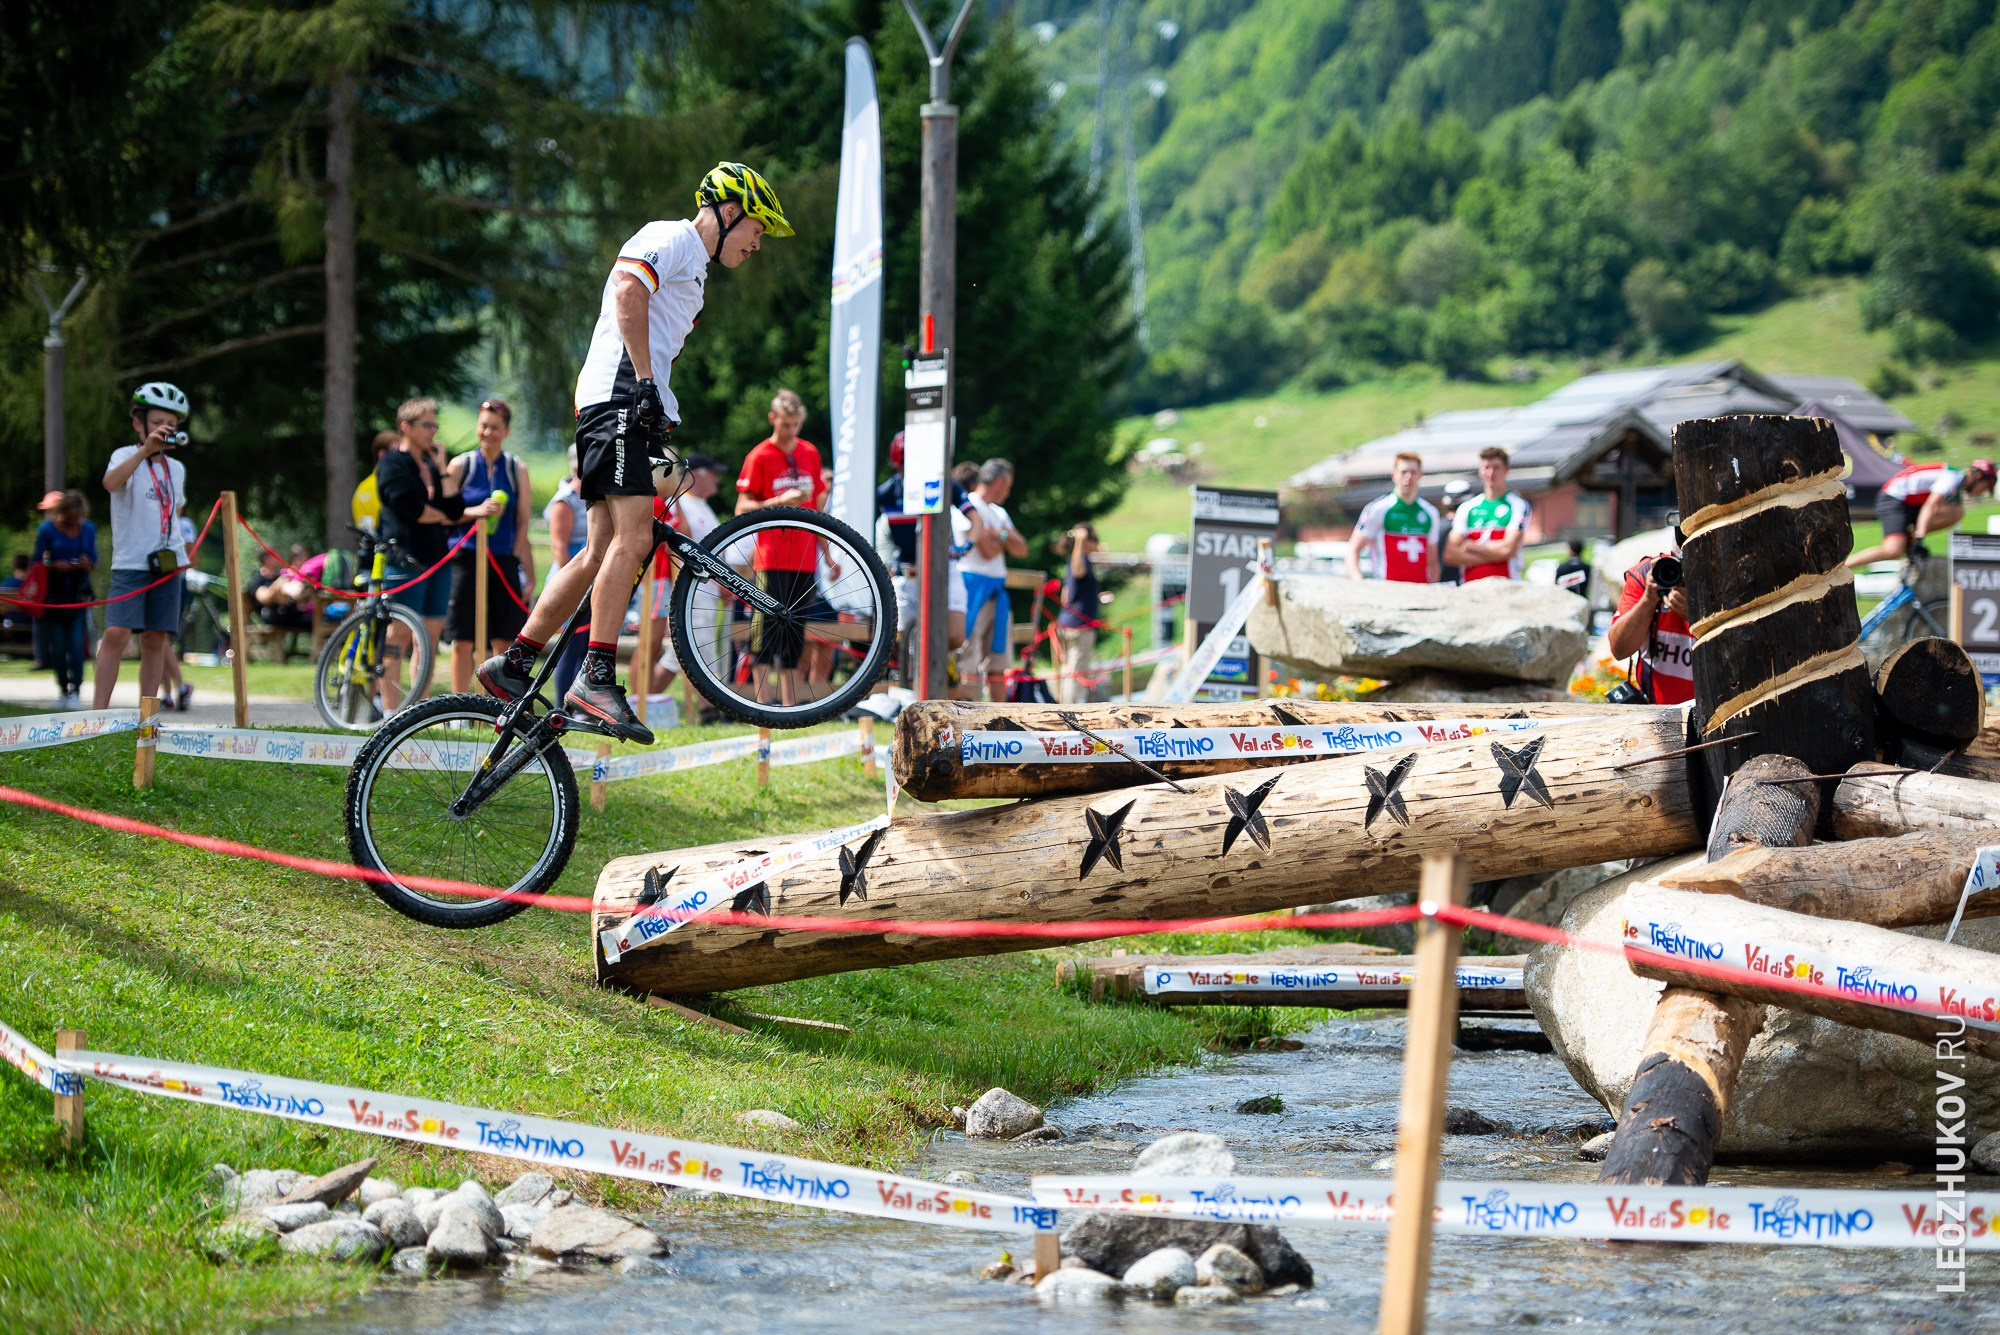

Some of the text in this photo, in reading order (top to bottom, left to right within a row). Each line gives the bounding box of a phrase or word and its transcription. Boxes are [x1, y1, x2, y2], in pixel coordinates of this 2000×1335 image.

[616, 408, 628, 436] TEAM
[1219, 567, 1242, 615] 1
[1971, 598, 1999, 642] 2
[1655, 642, 1693, 667] PHO
[962, 741, 1023, 760] ENTINO
[1038, 736, 1067, 757] Val
[1069, 743, 1082, 756] di
[1134, 735, 1214, 758] TRENTINO
[1229, 732, 1259, 752] Val
[1260, 738, 1272, 751] di
[1322, 730, 1402, 752] TRENTINO
[1417, 725, 1447, 743] Val
[1449, 731, 1460, 741] di
[634, 890, 708, 941] TRENTINO
[722, 870, 749, 891] Val
[812, 823, 878, 851] TRENTIN
[1187, 971, 1209, 986] Val
[1270, 971, 1338, 989] TRENTINO
[1356, 971, 1379, 986] Val
[1456, 973, 1506, 989] ENTINO
[1649, 922, 1724, 962] TRENTINO
[1744, 943, 1769, 973] Val
[1770, 961, 1783, 977] di
[1836, 966, 1918, 1006] TRENTINO
[1939, 986, 1966, 1016] Val
[1968, 1004, 1982, 1019] di
[217, 1080, 324, 1116] TRENTINO
[348, 1098, 384, 1128] Val
[387, 1117, 403, 1131] di
[475, 1121, 584, 1159] TRENTINO
[610, 1139, 645, 1171] Val
[649, 1158, 665, 1174] di
[739, 1161, 849, 1200] TRENTINO
[877, 1180, 912, 1211] Val
[916, 1198, 933, 1213] di
[1461, 1195, 1578, 1232] TRENTINO
[1606, 1197, 1644, 1228] Val
[1649, 1211, 1668, 1229] di
[1670, 1199, 1731, 1231] Sole
[1749, 1202, 1874, 1239] TRENTINO
[1902, 1203, 1944, 1237] Va
